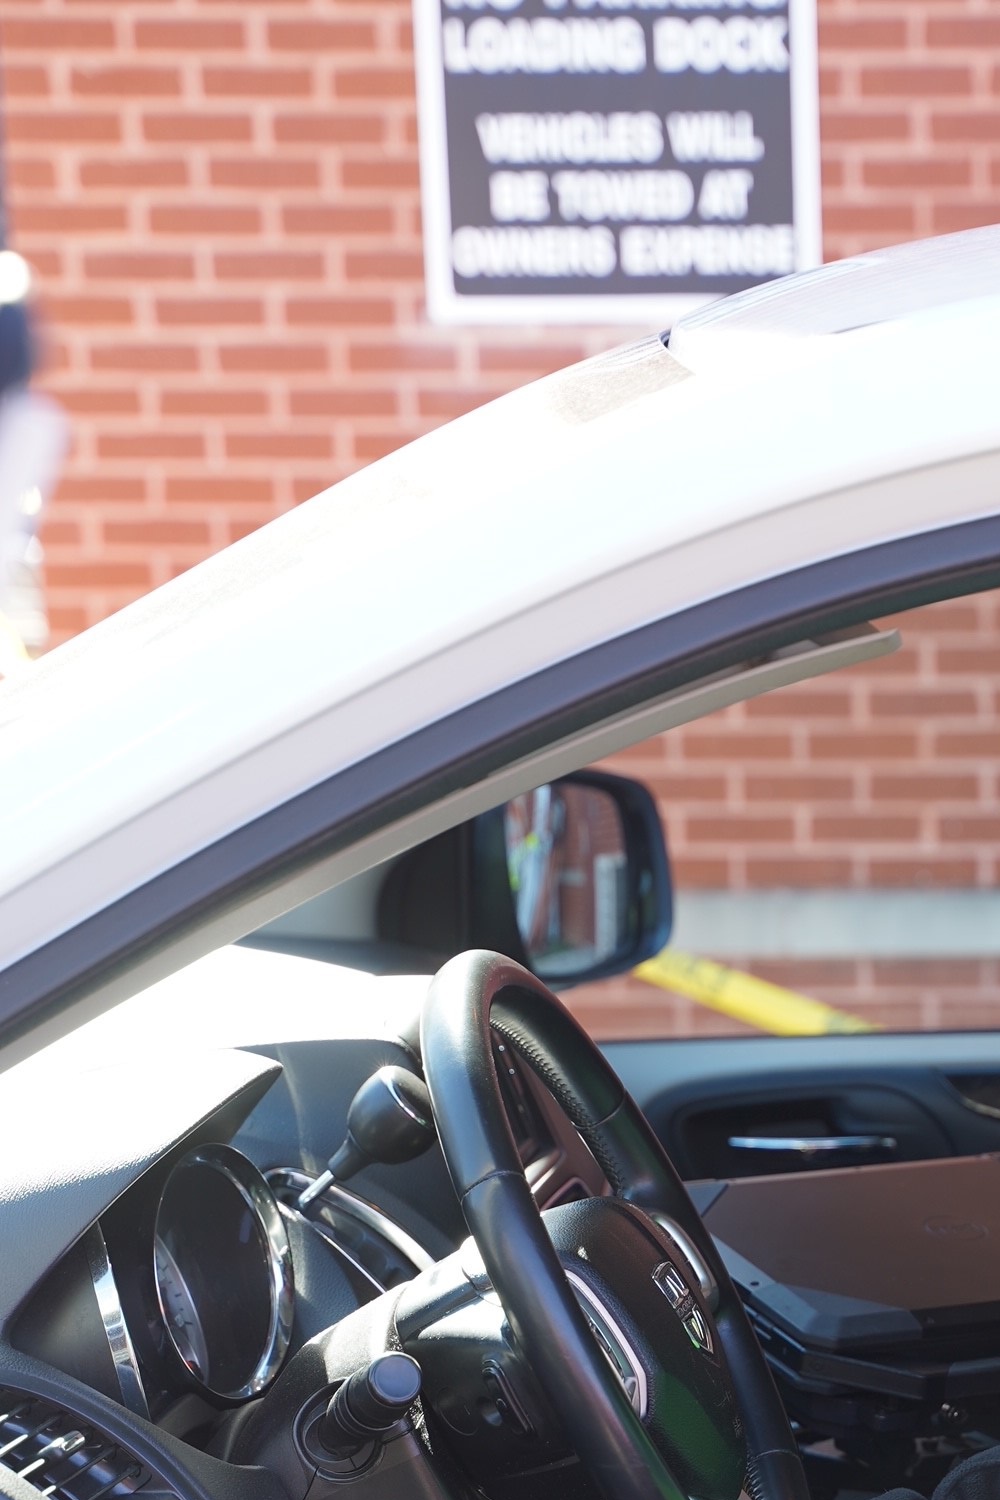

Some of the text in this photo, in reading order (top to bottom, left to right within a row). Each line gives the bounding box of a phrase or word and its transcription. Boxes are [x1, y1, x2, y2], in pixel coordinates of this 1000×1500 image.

[443, 16, 789, 74] LOADING DOCK
[475, 110, 764, 163] VEHICLES WILL
[489, 169, 754, 221] BE TOWED AT
[451, 224, 796, 278] OWNERS EXPENSE
